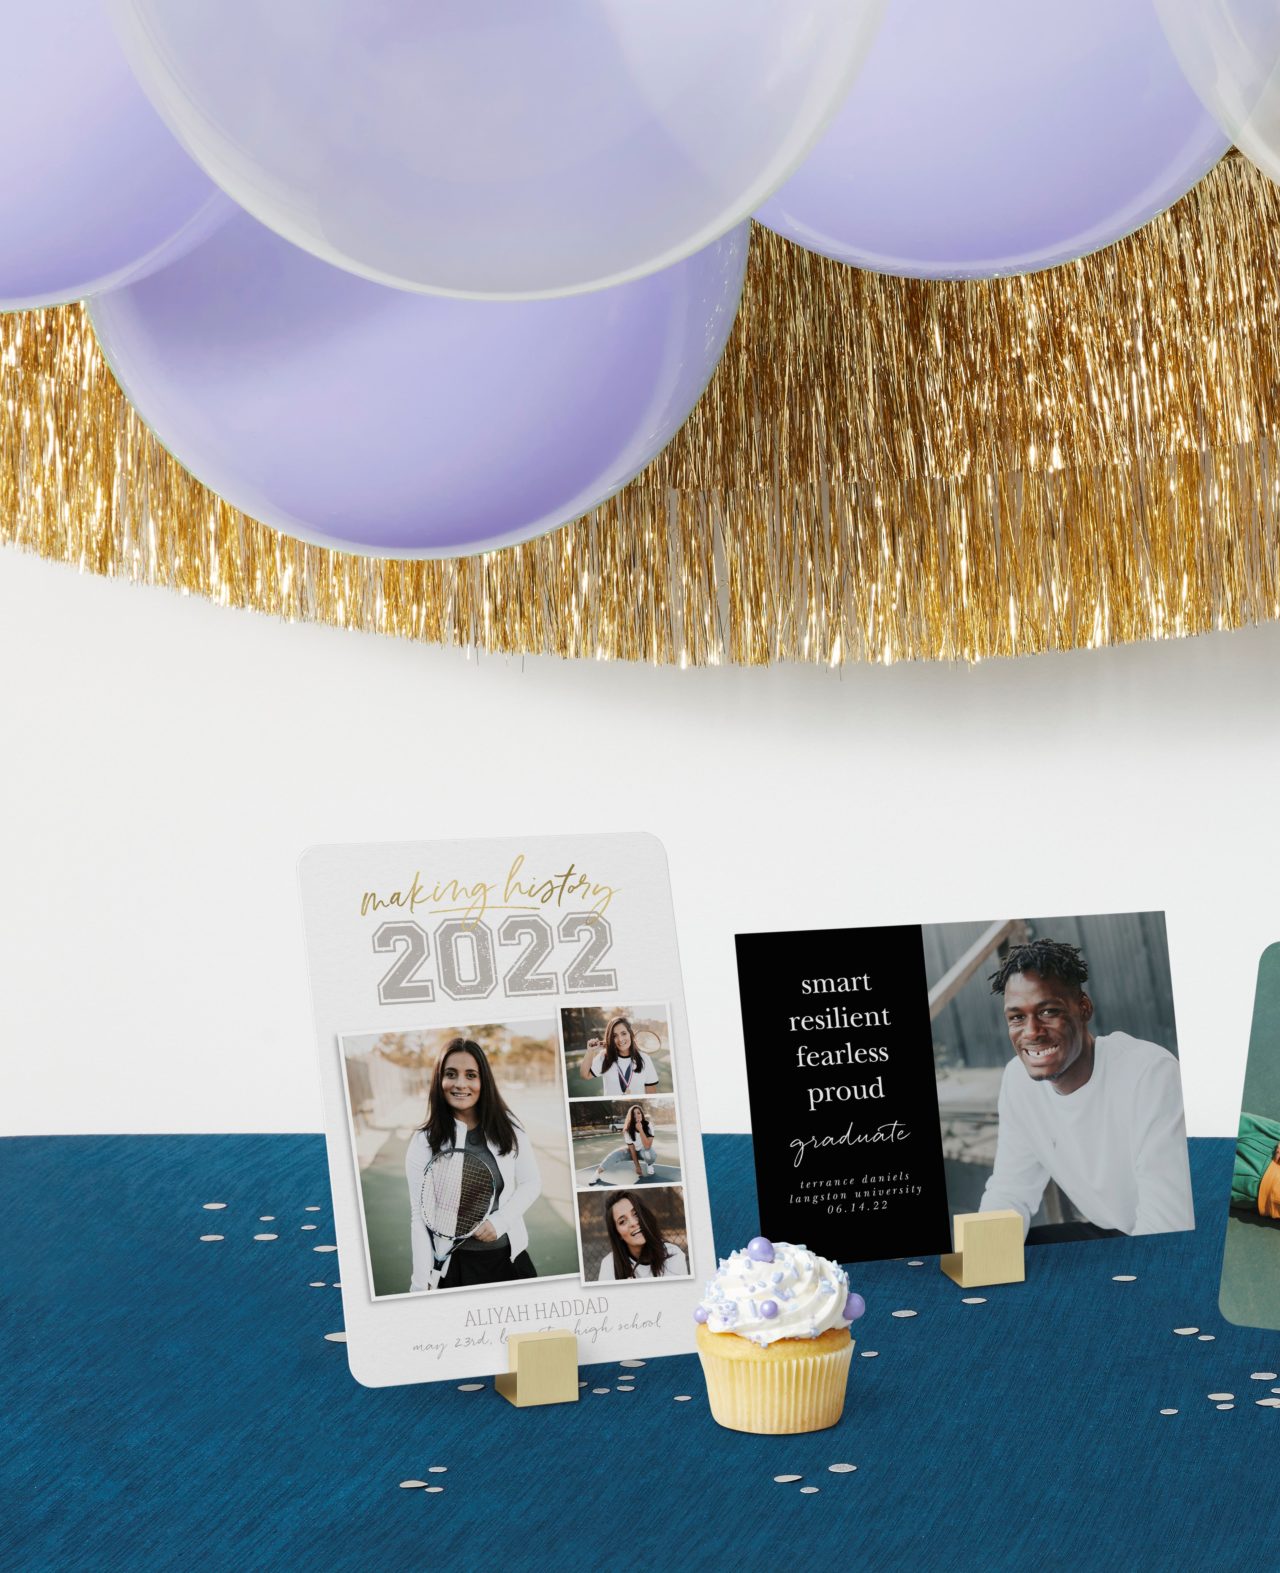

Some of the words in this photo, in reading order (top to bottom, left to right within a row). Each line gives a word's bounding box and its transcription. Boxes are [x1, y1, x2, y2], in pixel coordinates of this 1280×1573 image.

[361, 872, 497, 931] making
[503, 855, 622, 926] history
[372, 911, 618, 1005] 2022
[801, 973, 873, 995] smart
[788, 1006, 892, 1032] resilient
[796, 1042, 889, 1068] fearless
[807, 1076, 886, 1112] proud
[789, 1120, 912, 1168] graduate
[789, 1192, 847, 1205] langston
[854, 1184, 922, 1199] university
[800, 1176, 855, 1190] terrance
[861, 1171, 910, 1185] daniels
[827, 1200, 889, 1215] 06.14.22
[464, 1303, 531, 1328] ALIYAH
[534, 1296, 610, 1320] HADDAD
[412, 1340, 448, 1360] may
[574, 1318, 613, 1345] high
[618, 1310, 664, 1332] school
